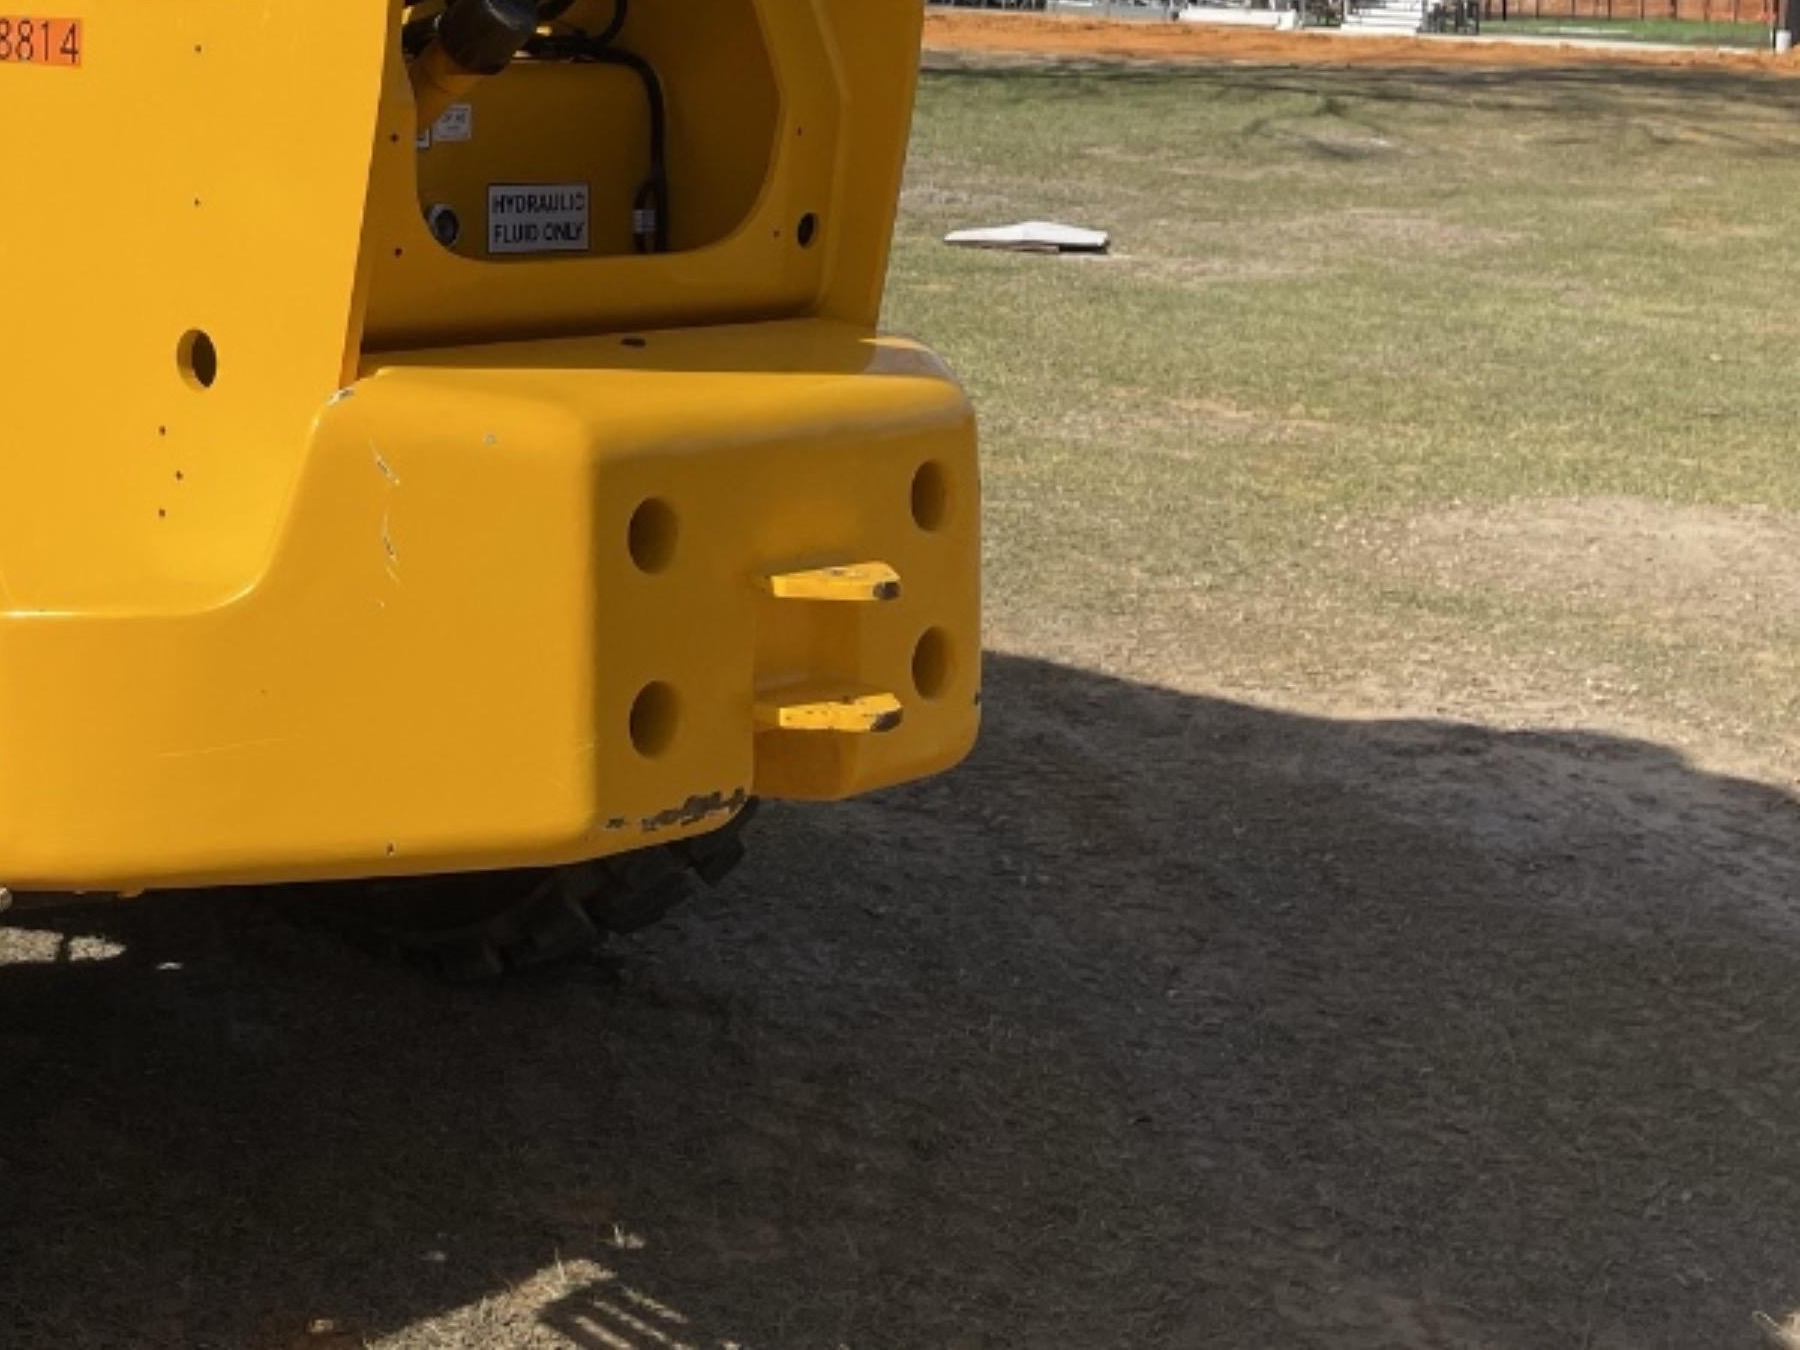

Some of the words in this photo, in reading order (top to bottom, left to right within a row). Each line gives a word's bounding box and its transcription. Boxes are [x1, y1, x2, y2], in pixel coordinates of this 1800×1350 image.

[492, 192, 585, 214] HYDRAULIC
[494, 223, 538, 244] FLUID
[543, 221, 585, 241] ONLY
